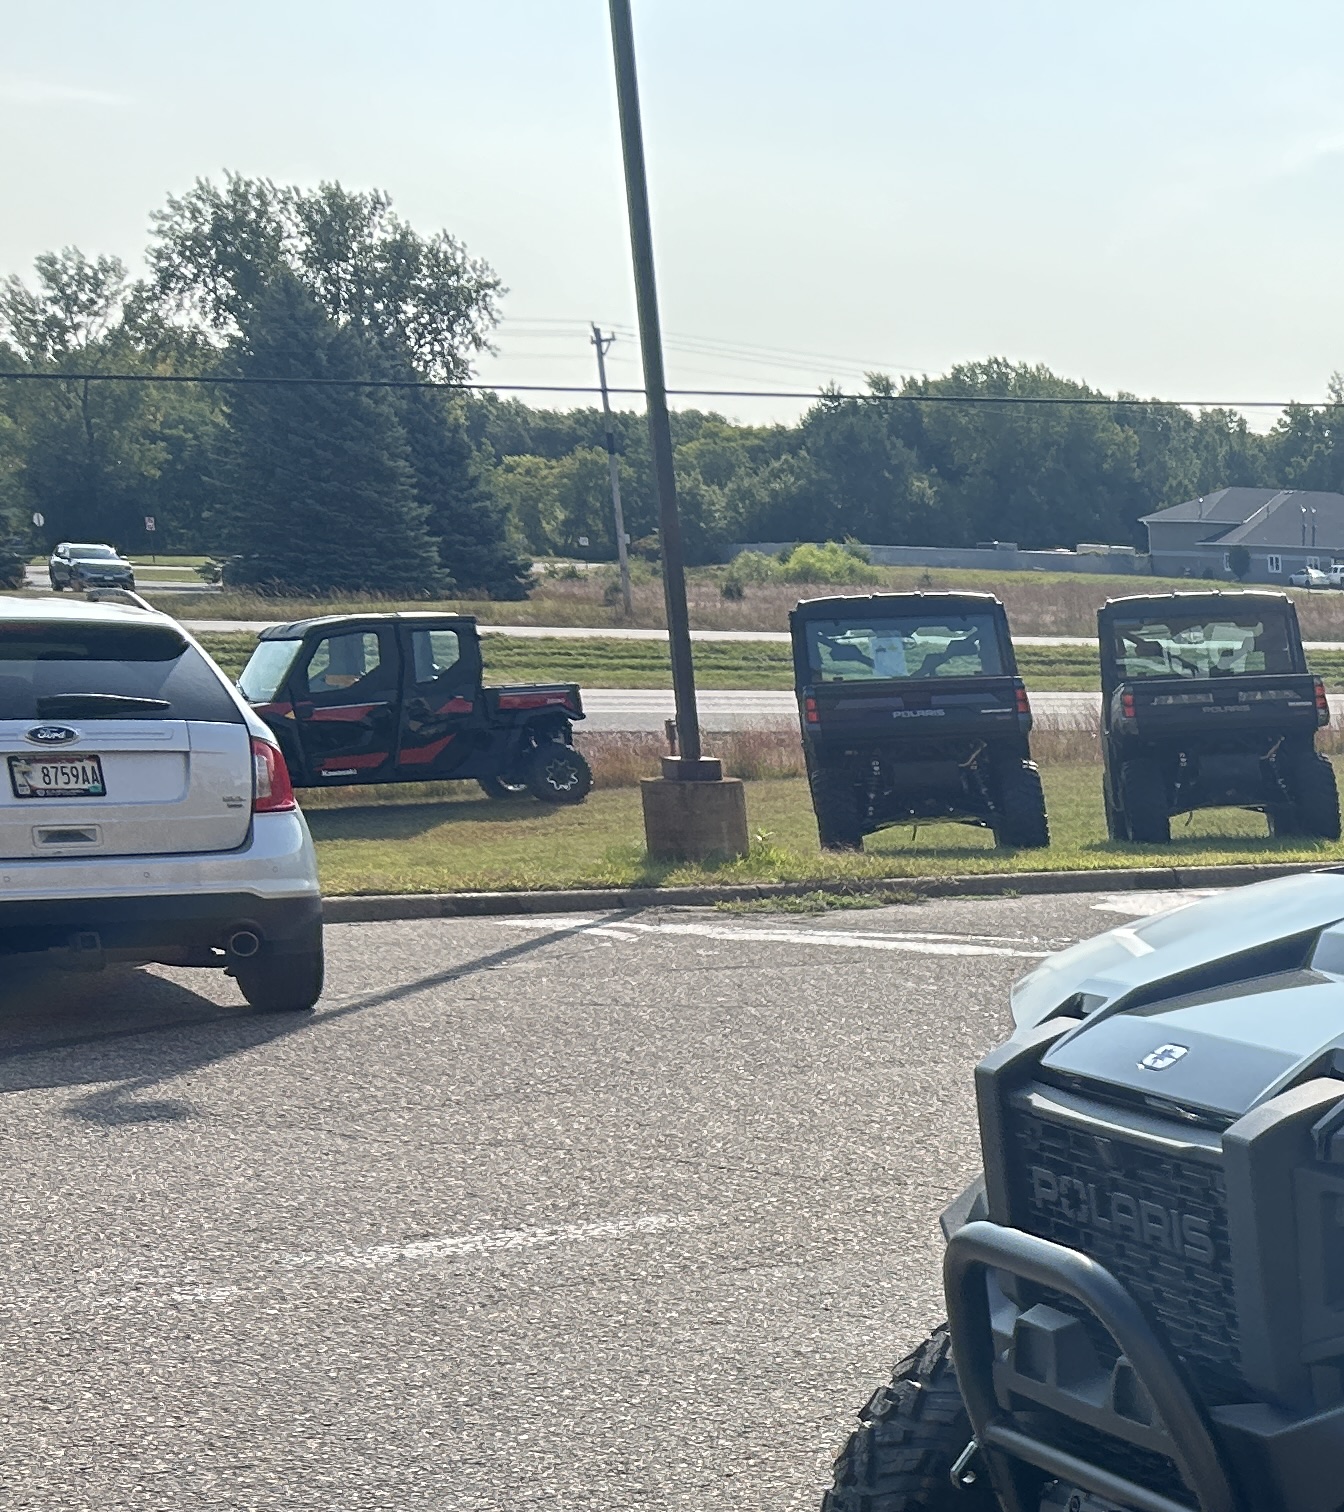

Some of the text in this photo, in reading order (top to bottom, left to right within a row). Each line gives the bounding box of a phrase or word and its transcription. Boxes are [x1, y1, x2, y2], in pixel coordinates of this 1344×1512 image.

[892, 709, 946, 718] POLARIS
[37, 727, 68, 739] Ford
[41, 765, 100, 785] 8759AA
[1031, 1165, 1216, 1265] POLARIS
